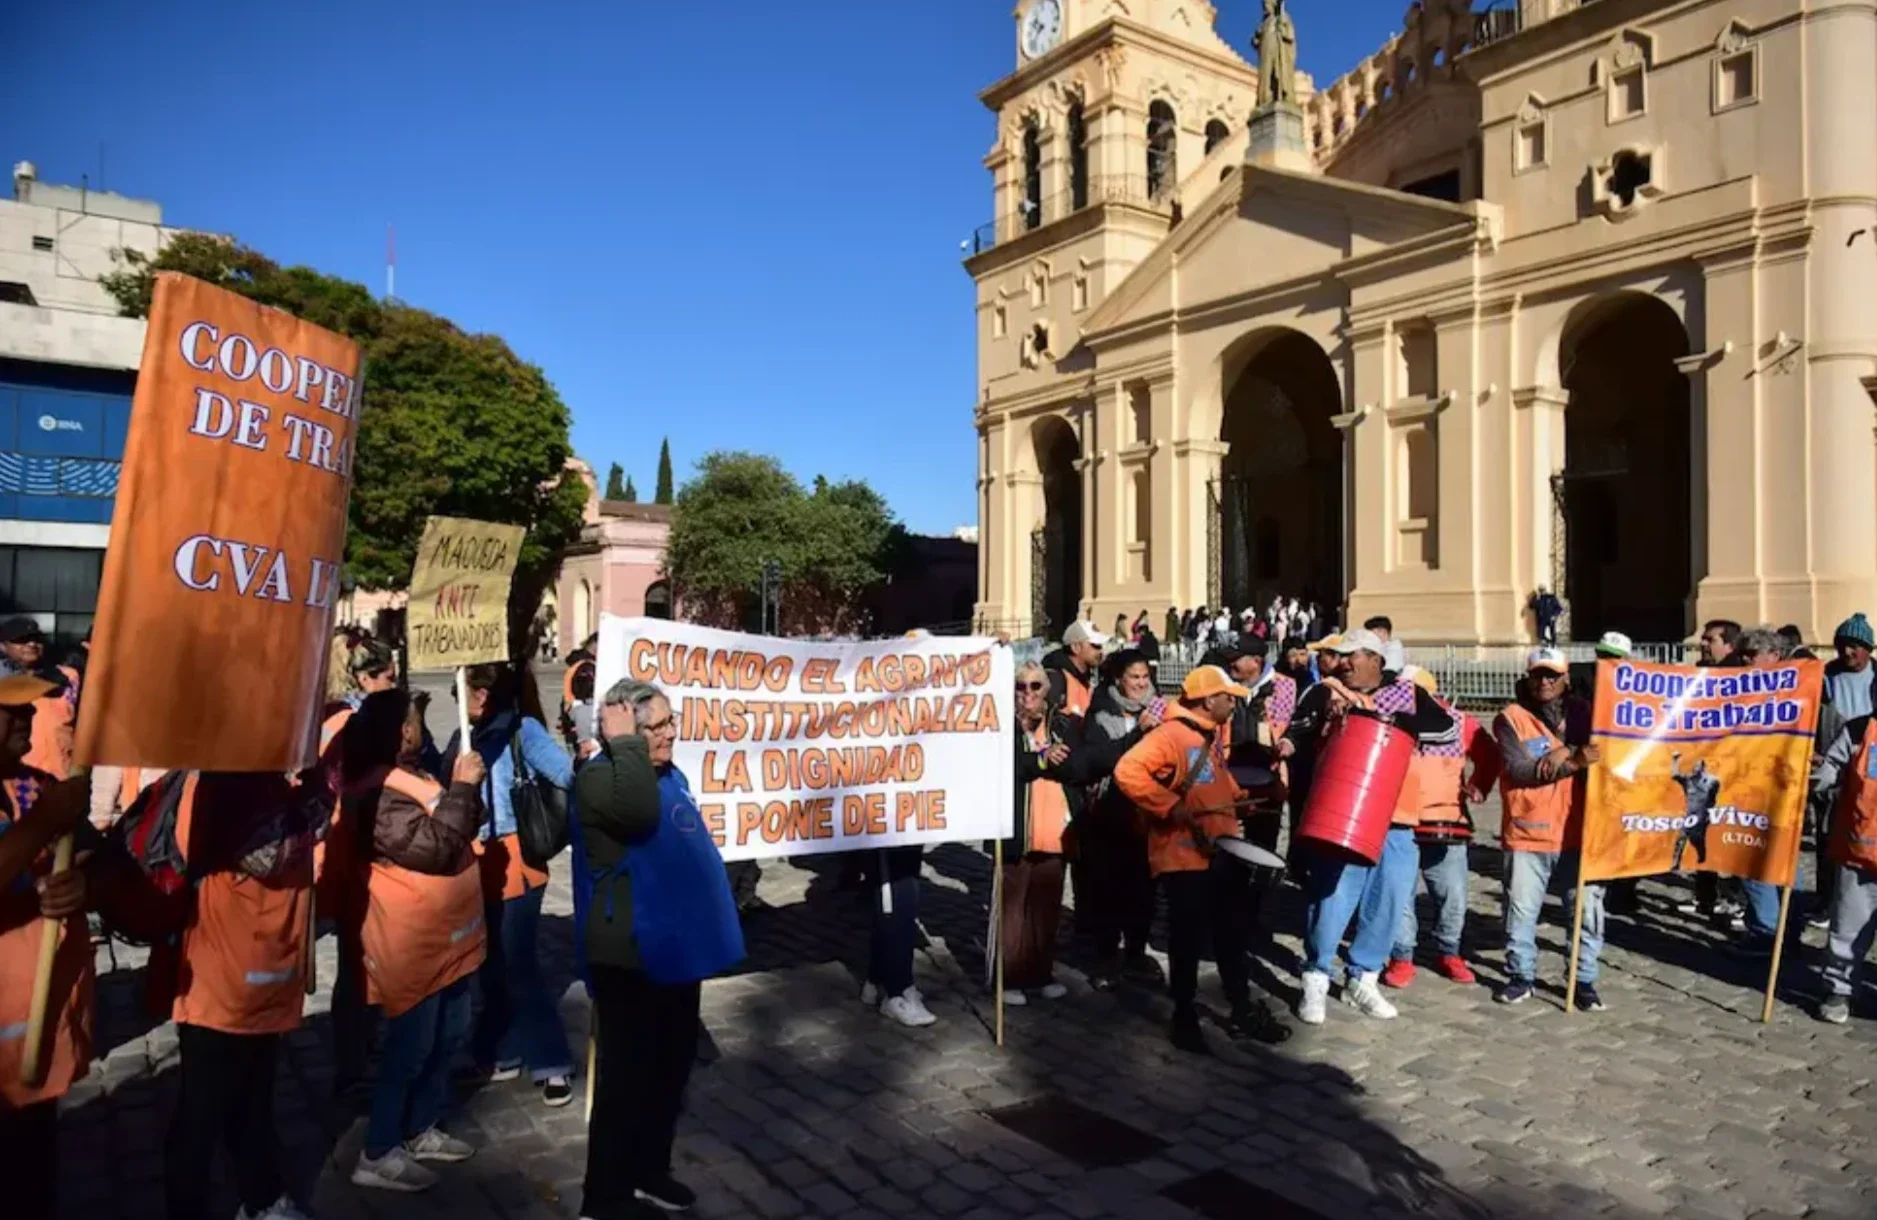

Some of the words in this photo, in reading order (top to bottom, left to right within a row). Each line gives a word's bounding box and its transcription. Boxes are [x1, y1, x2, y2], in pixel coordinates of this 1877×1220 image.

[189, 386, 271, 451] DE
[173, 534, 293, 601] CVA
[628, 637, 795, 693] CUANDO
[799, 656, 846, 695] EL
[1615, 665, 1798, 698] Cooperativa
[679, 693, 1001, 742] INSTITUCIONALIZA
[1615, 699, 1654, 729] de
[701, 748, 753, 794] LA
[761, 742, 925, 792] DIGNIDAD
[699, 803, 726, 848] E
[736, 799, 835, 846] PONE
[842, 791, 888, 837] DE
[895, 789, 948, 832] PIE
[1621, 813, 1699, 833] Tosco
[1706, 805, 1770, 831] Vive
